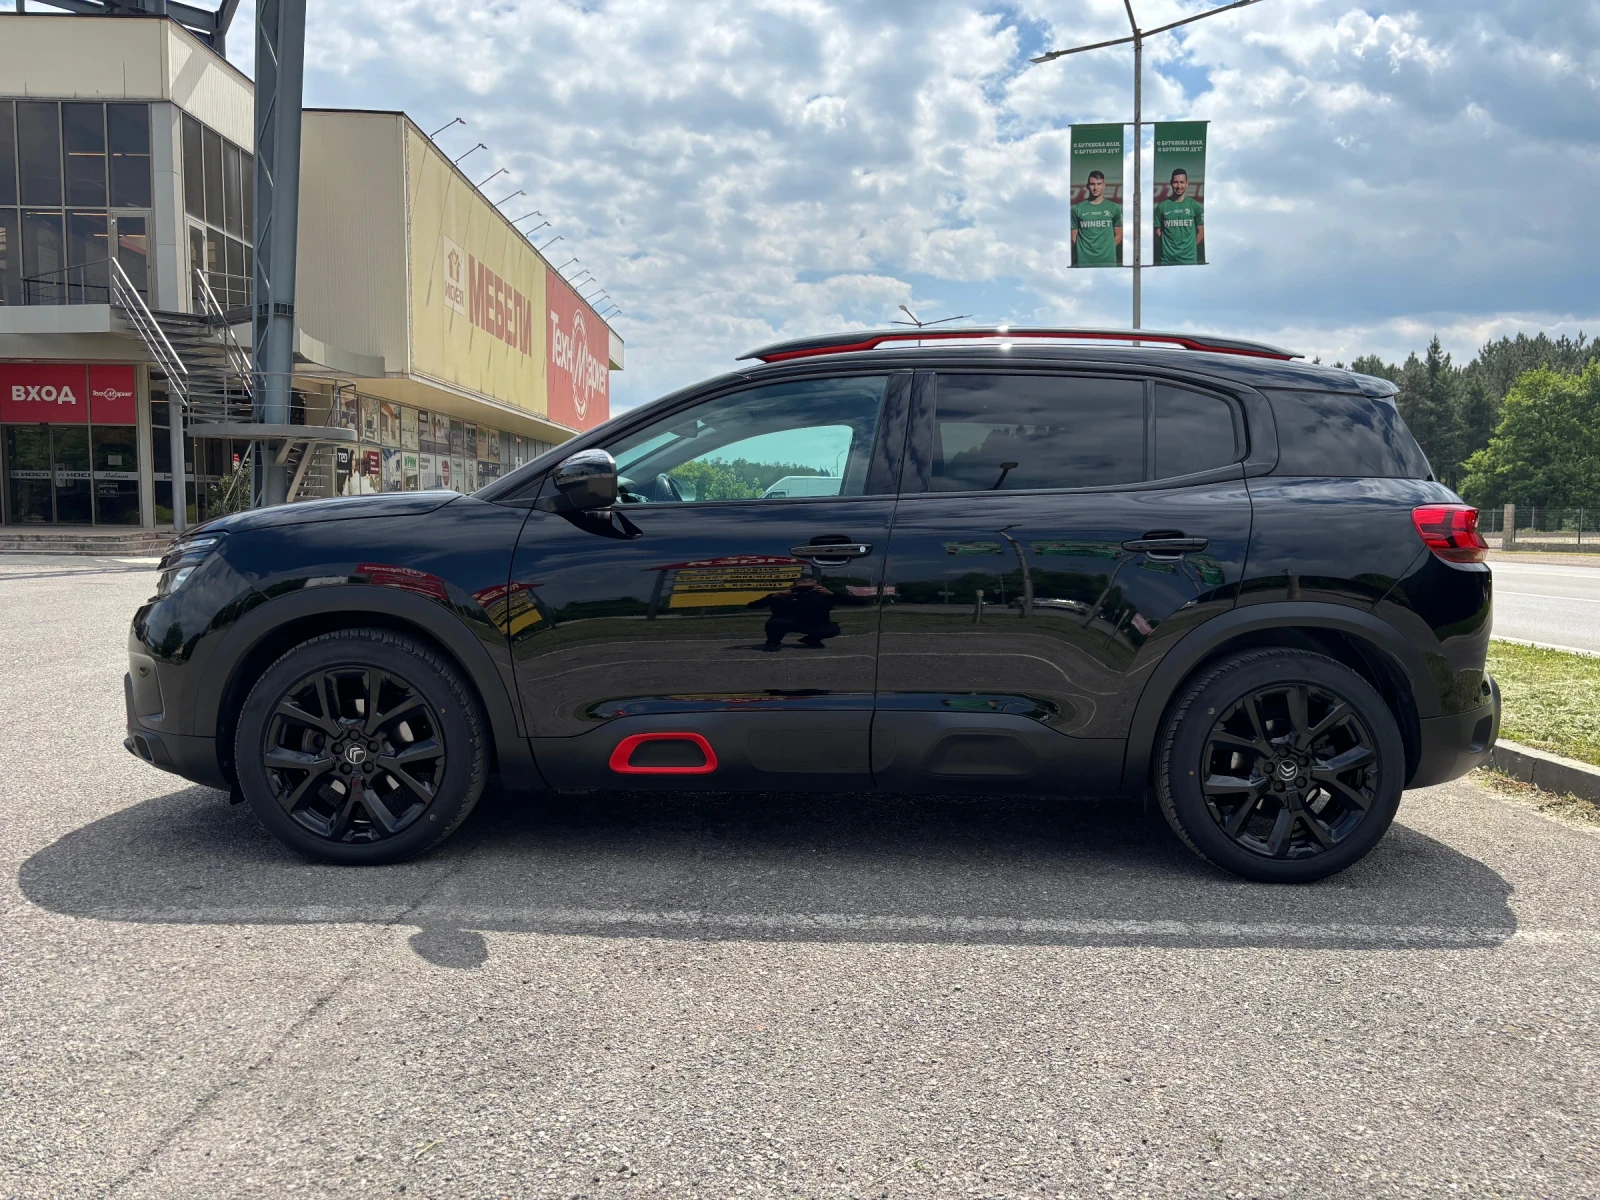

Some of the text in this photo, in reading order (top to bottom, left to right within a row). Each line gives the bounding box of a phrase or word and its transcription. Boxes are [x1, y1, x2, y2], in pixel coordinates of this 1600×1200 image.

[1080, 219, 1112, 228] WINBET
[1163, 219, 1194, 227] WINBET
[468, 253, 532, 358] МЕБЕЛИ
[11, 385, 76, 404] ВХОД
